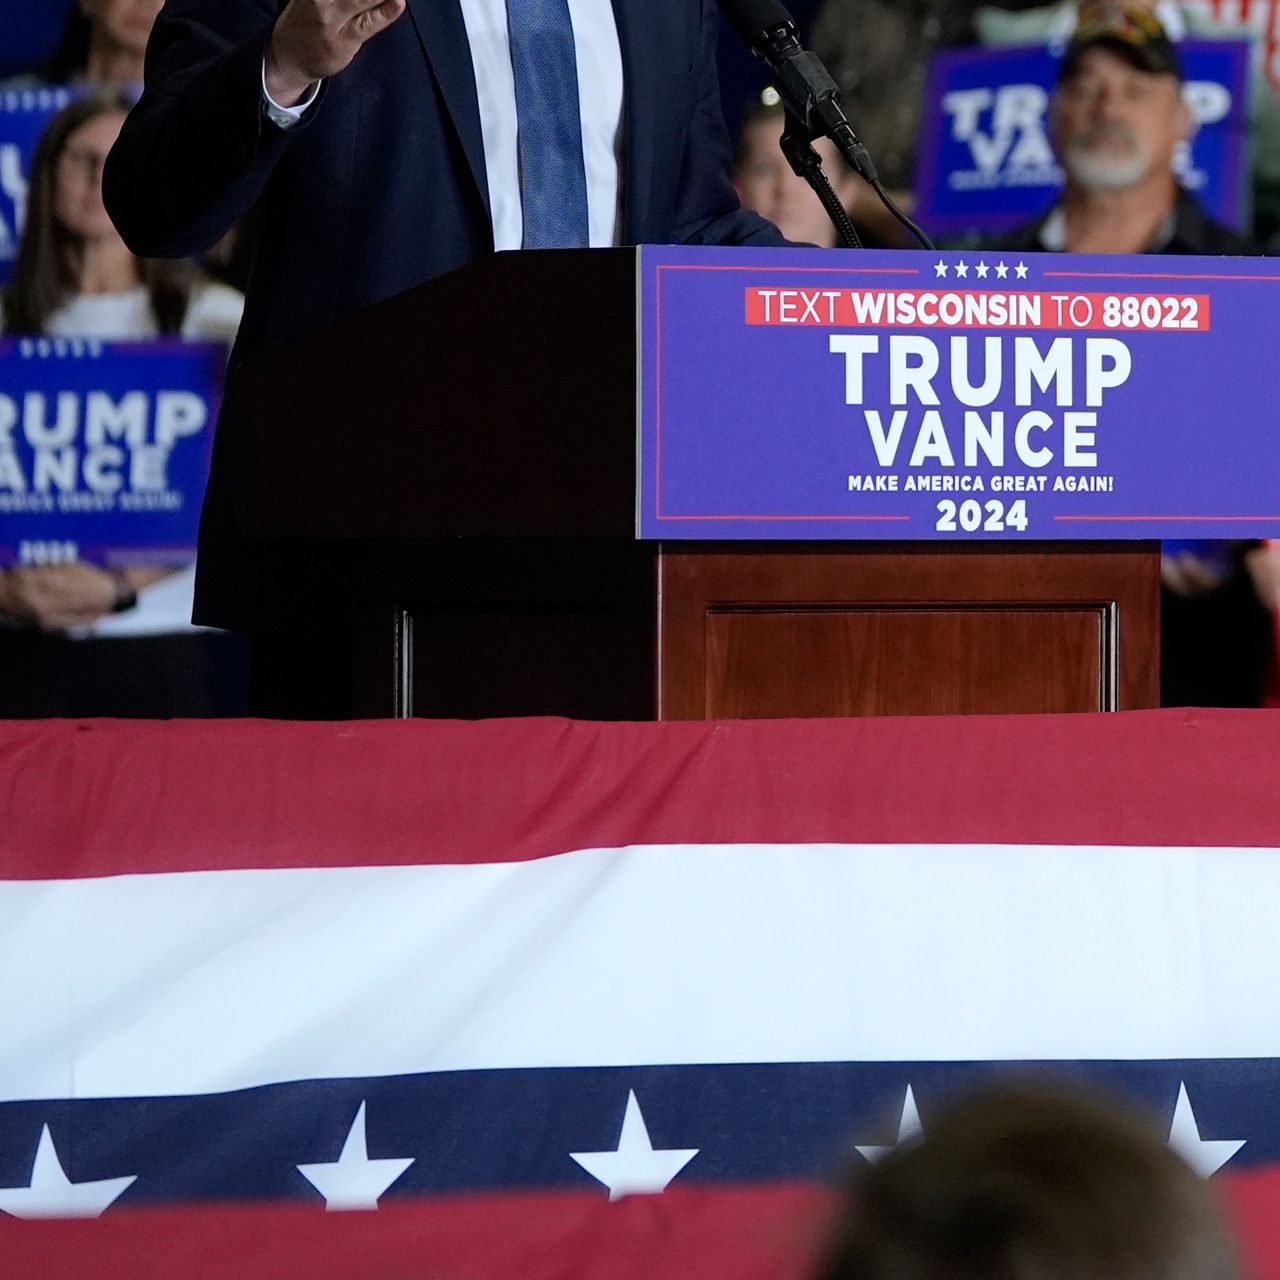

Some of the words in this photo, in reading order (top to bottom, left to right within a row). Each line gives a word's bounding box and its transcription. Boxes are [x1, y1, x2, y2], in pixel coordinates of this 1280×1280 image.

[756, 290, 842, 324] TEXT
[850, 291, 1042, 327] WISCONSIN
[1050, 294, 1093, 327] TO
[1101, 294, 1199, 329] 88022
[829, 333, 1132, 407] TRUMP
[863, 410, 1099, 468] VANCE
[847, 474, 899, 492] MAKE
[903, 475, 985, 493] AMERICA
[990, 475, 1048, 493] GREAT
[1052, 475, 1114, 493] AGAIN!
[936, 499, 1029, 532] 2024
